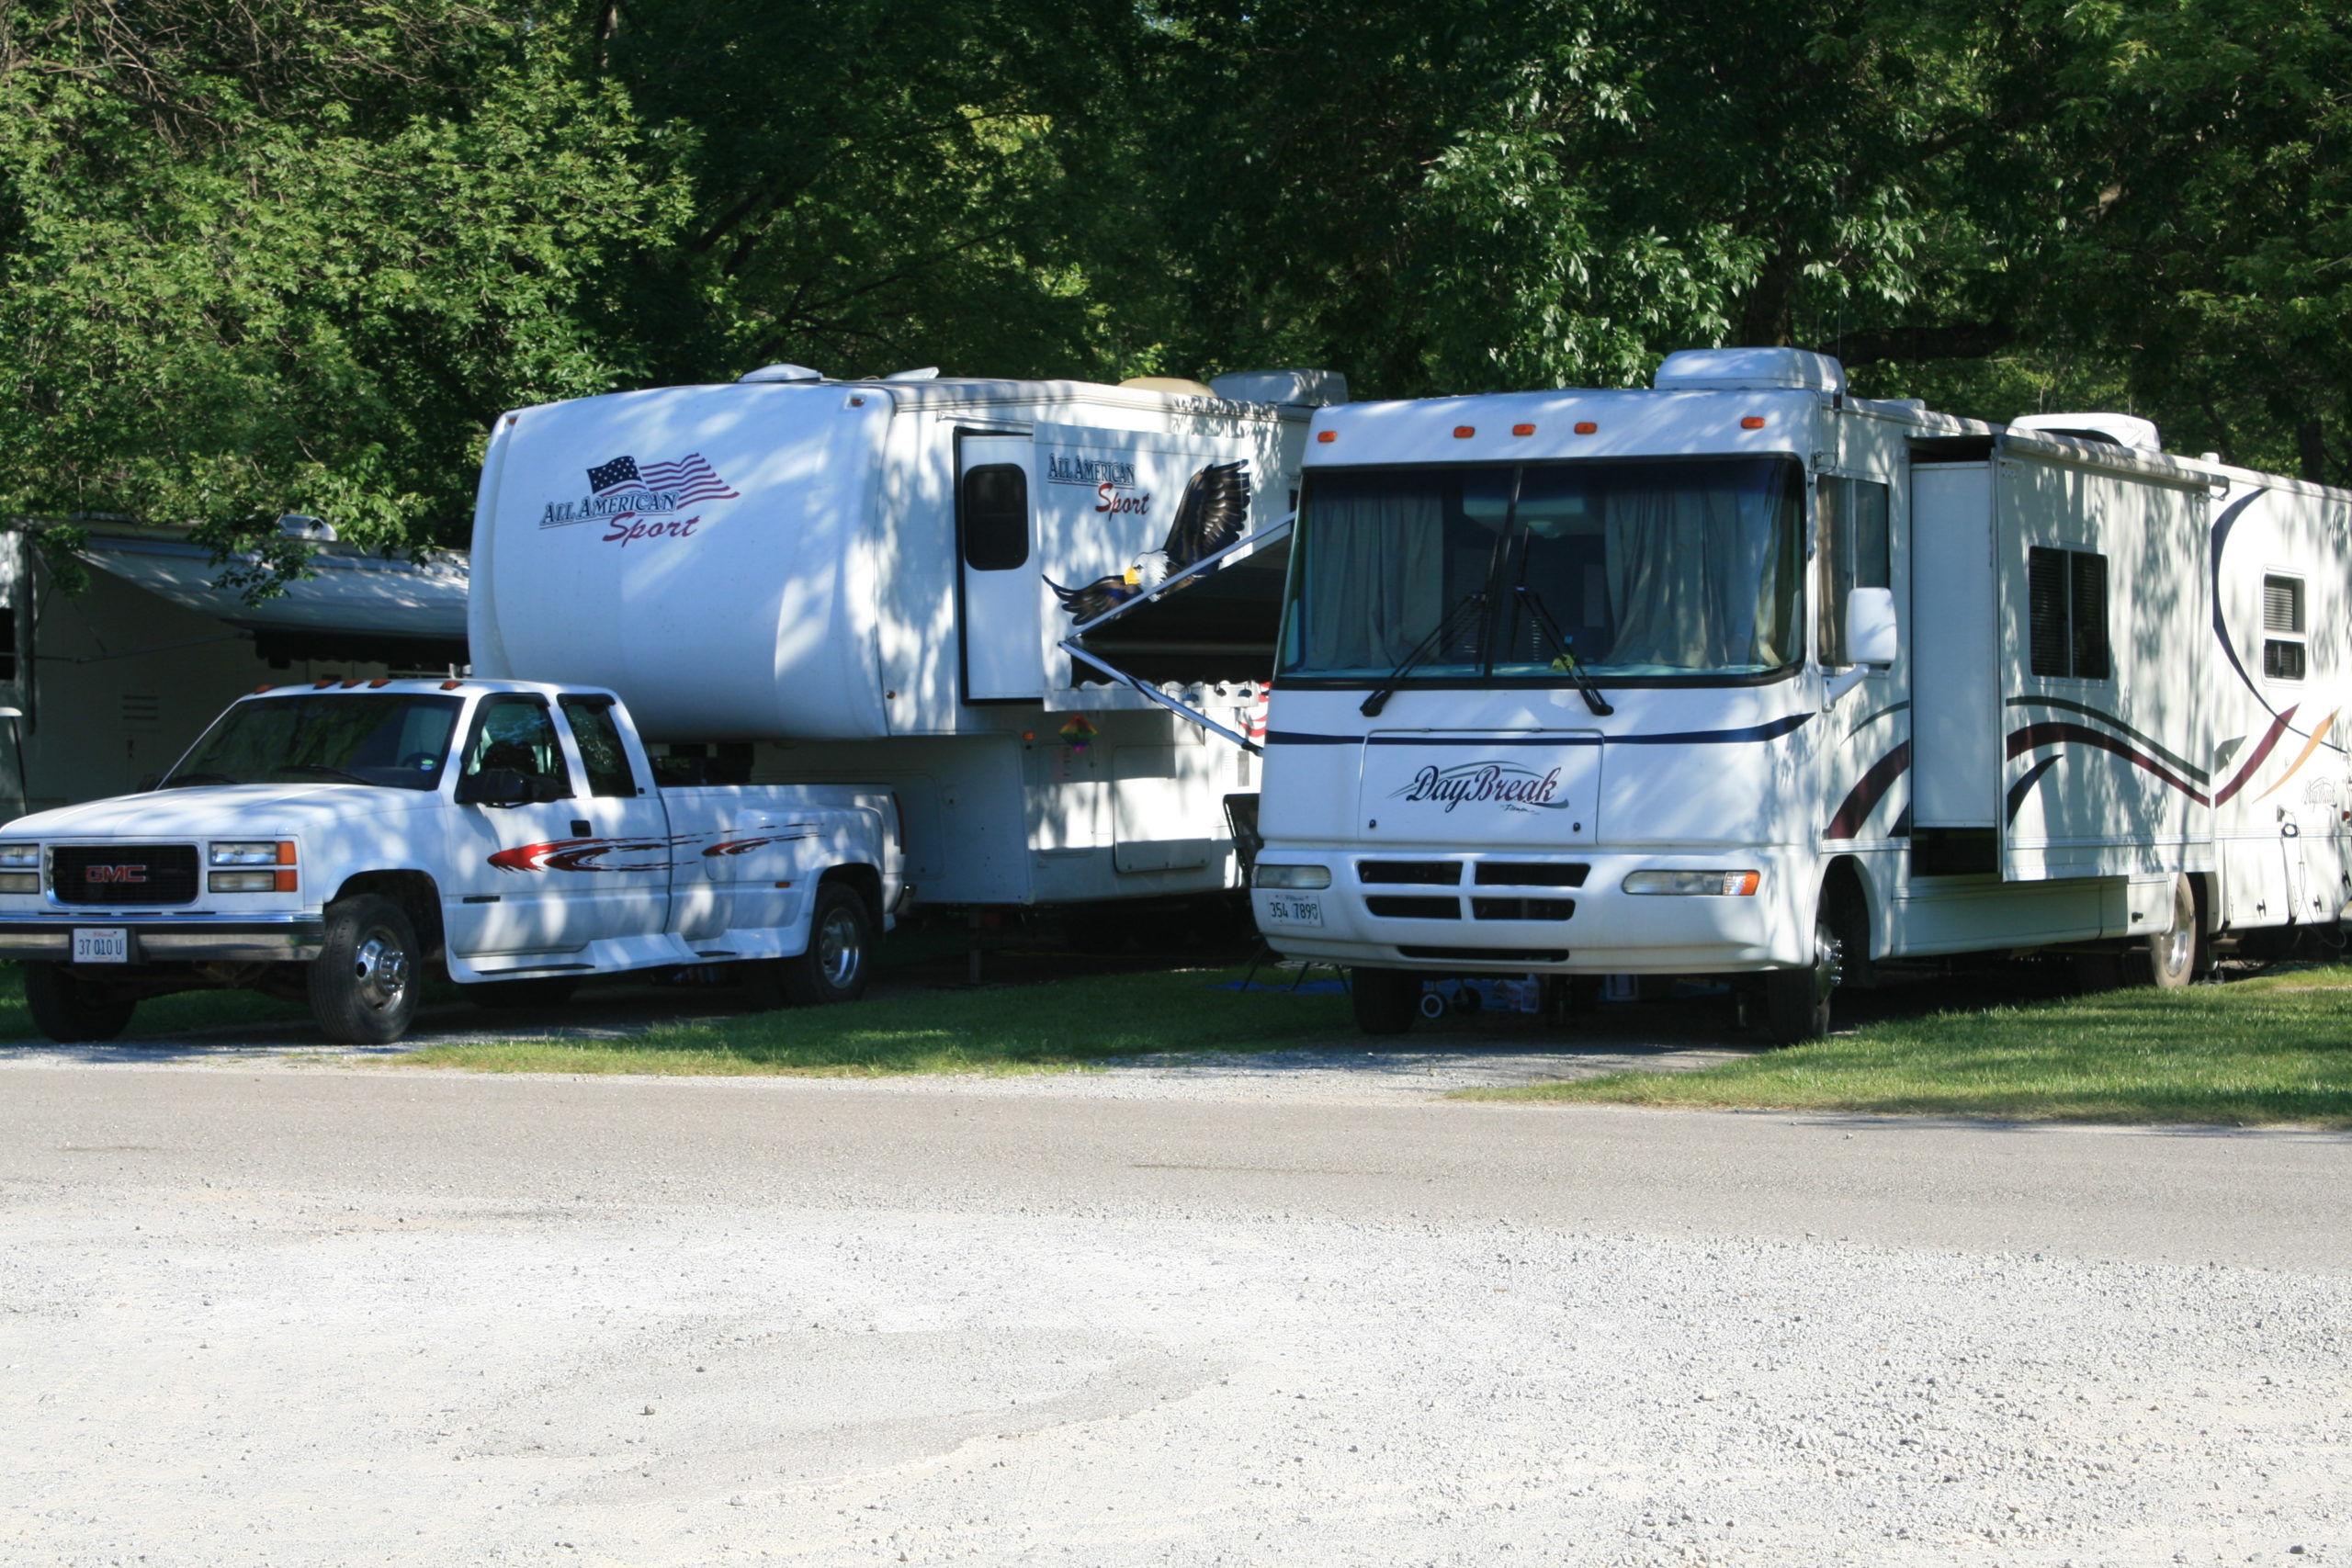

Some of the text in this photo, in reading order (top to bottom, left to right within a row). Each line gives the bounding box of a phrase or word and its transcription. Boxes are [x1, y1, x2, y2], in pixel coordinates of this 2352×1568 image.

[1074, 455, 1136, 486] AMERICAN
[576, 491, 680, 521] AMERICAN
[1095, 482, 1149, 522] Sport
[602, 511, 700, 547] Sport
[1406, 764, 1562, 813] DayBreak
[85, 864, 147, 882] GMC
[1270, 902, 1289, 918] 354
[79, 939, 91, 955] 37
[116, 939, 122, 955] U
